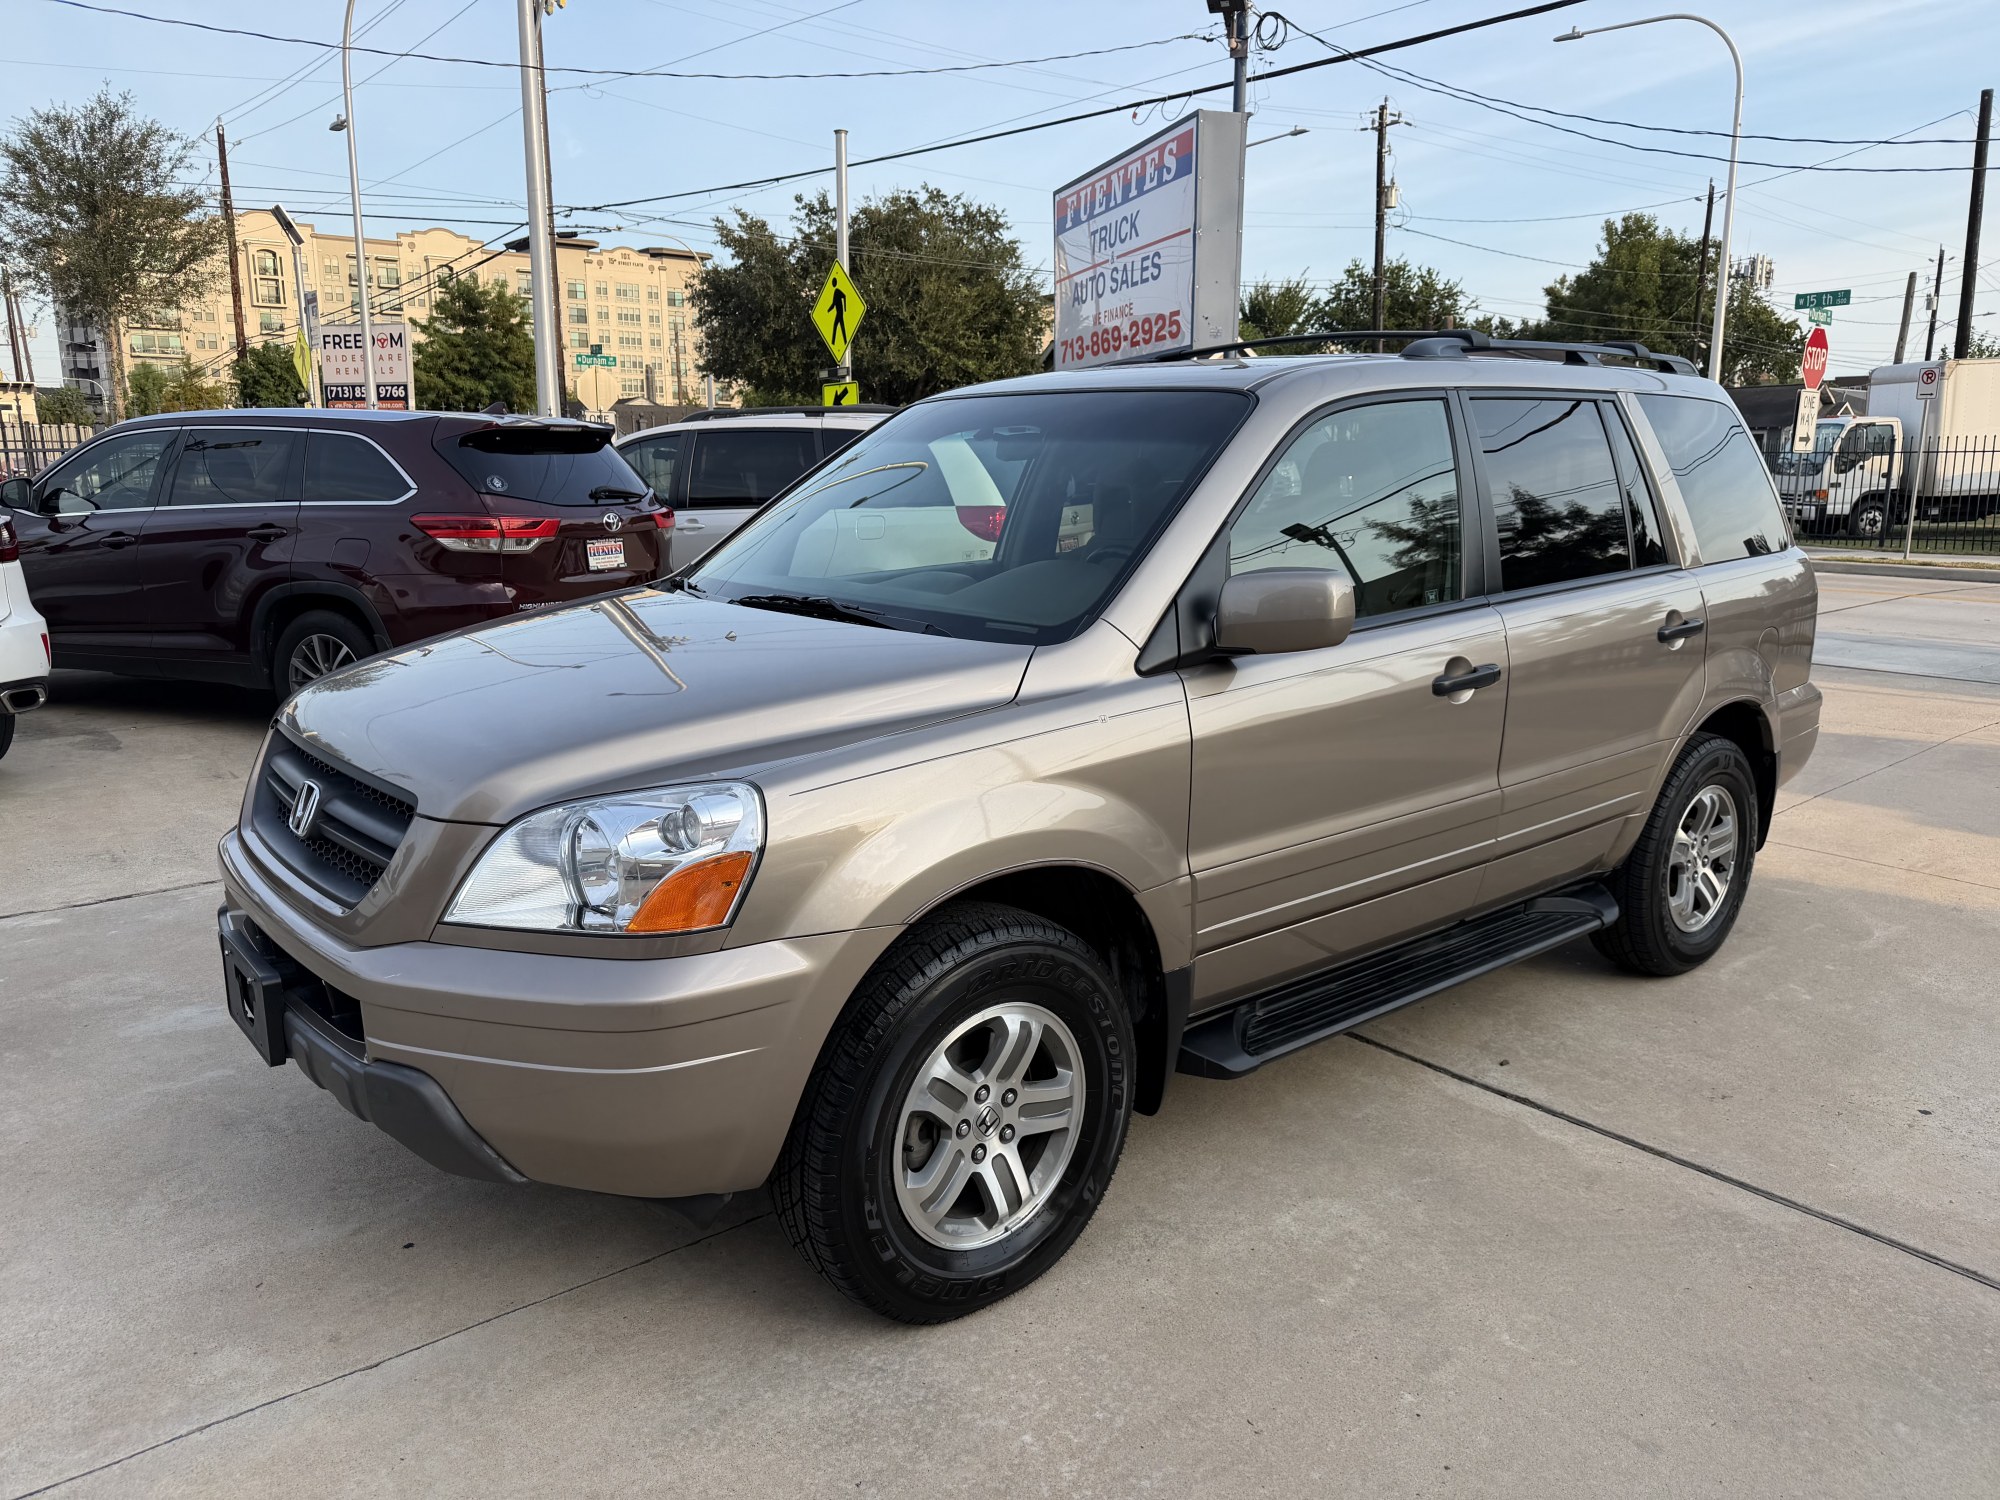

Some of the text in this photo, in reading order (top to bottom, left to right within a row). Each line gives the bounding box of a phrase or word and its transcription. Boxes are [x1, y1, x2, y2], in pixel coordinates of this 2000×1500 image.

[1065, 139, 1178, 229] FUENTES
[1090, 209, 1141, 256] TRUCK
[1071, 251, 1162, 308] AUTO SALES
[1806, 295, 1817, 307] 15
[1822, 293, 1833, 305] th
[1104, 302, 1134, 324] FINANCE
[322, 332, 403, 350] FREEOM
[1060, 310, 1182, 364] 713-869-2925
[325, 353, 402, 363] RIDESARE
[582, 355, 607, 366] Durham
[1804, 346, 1827, 370] STOP
[336, 367, 394, 376] RENLS
[327, 386, 353, 399] (713)
[1803, 395, 1816, 409] ONE
[589, 414, 609, 423] ONE
[1800, 412, 1815, 426] WAY
[590, 545, 621, 557] FUENTES
[965, 957, 1125, 1112] BRIDGESTONE
